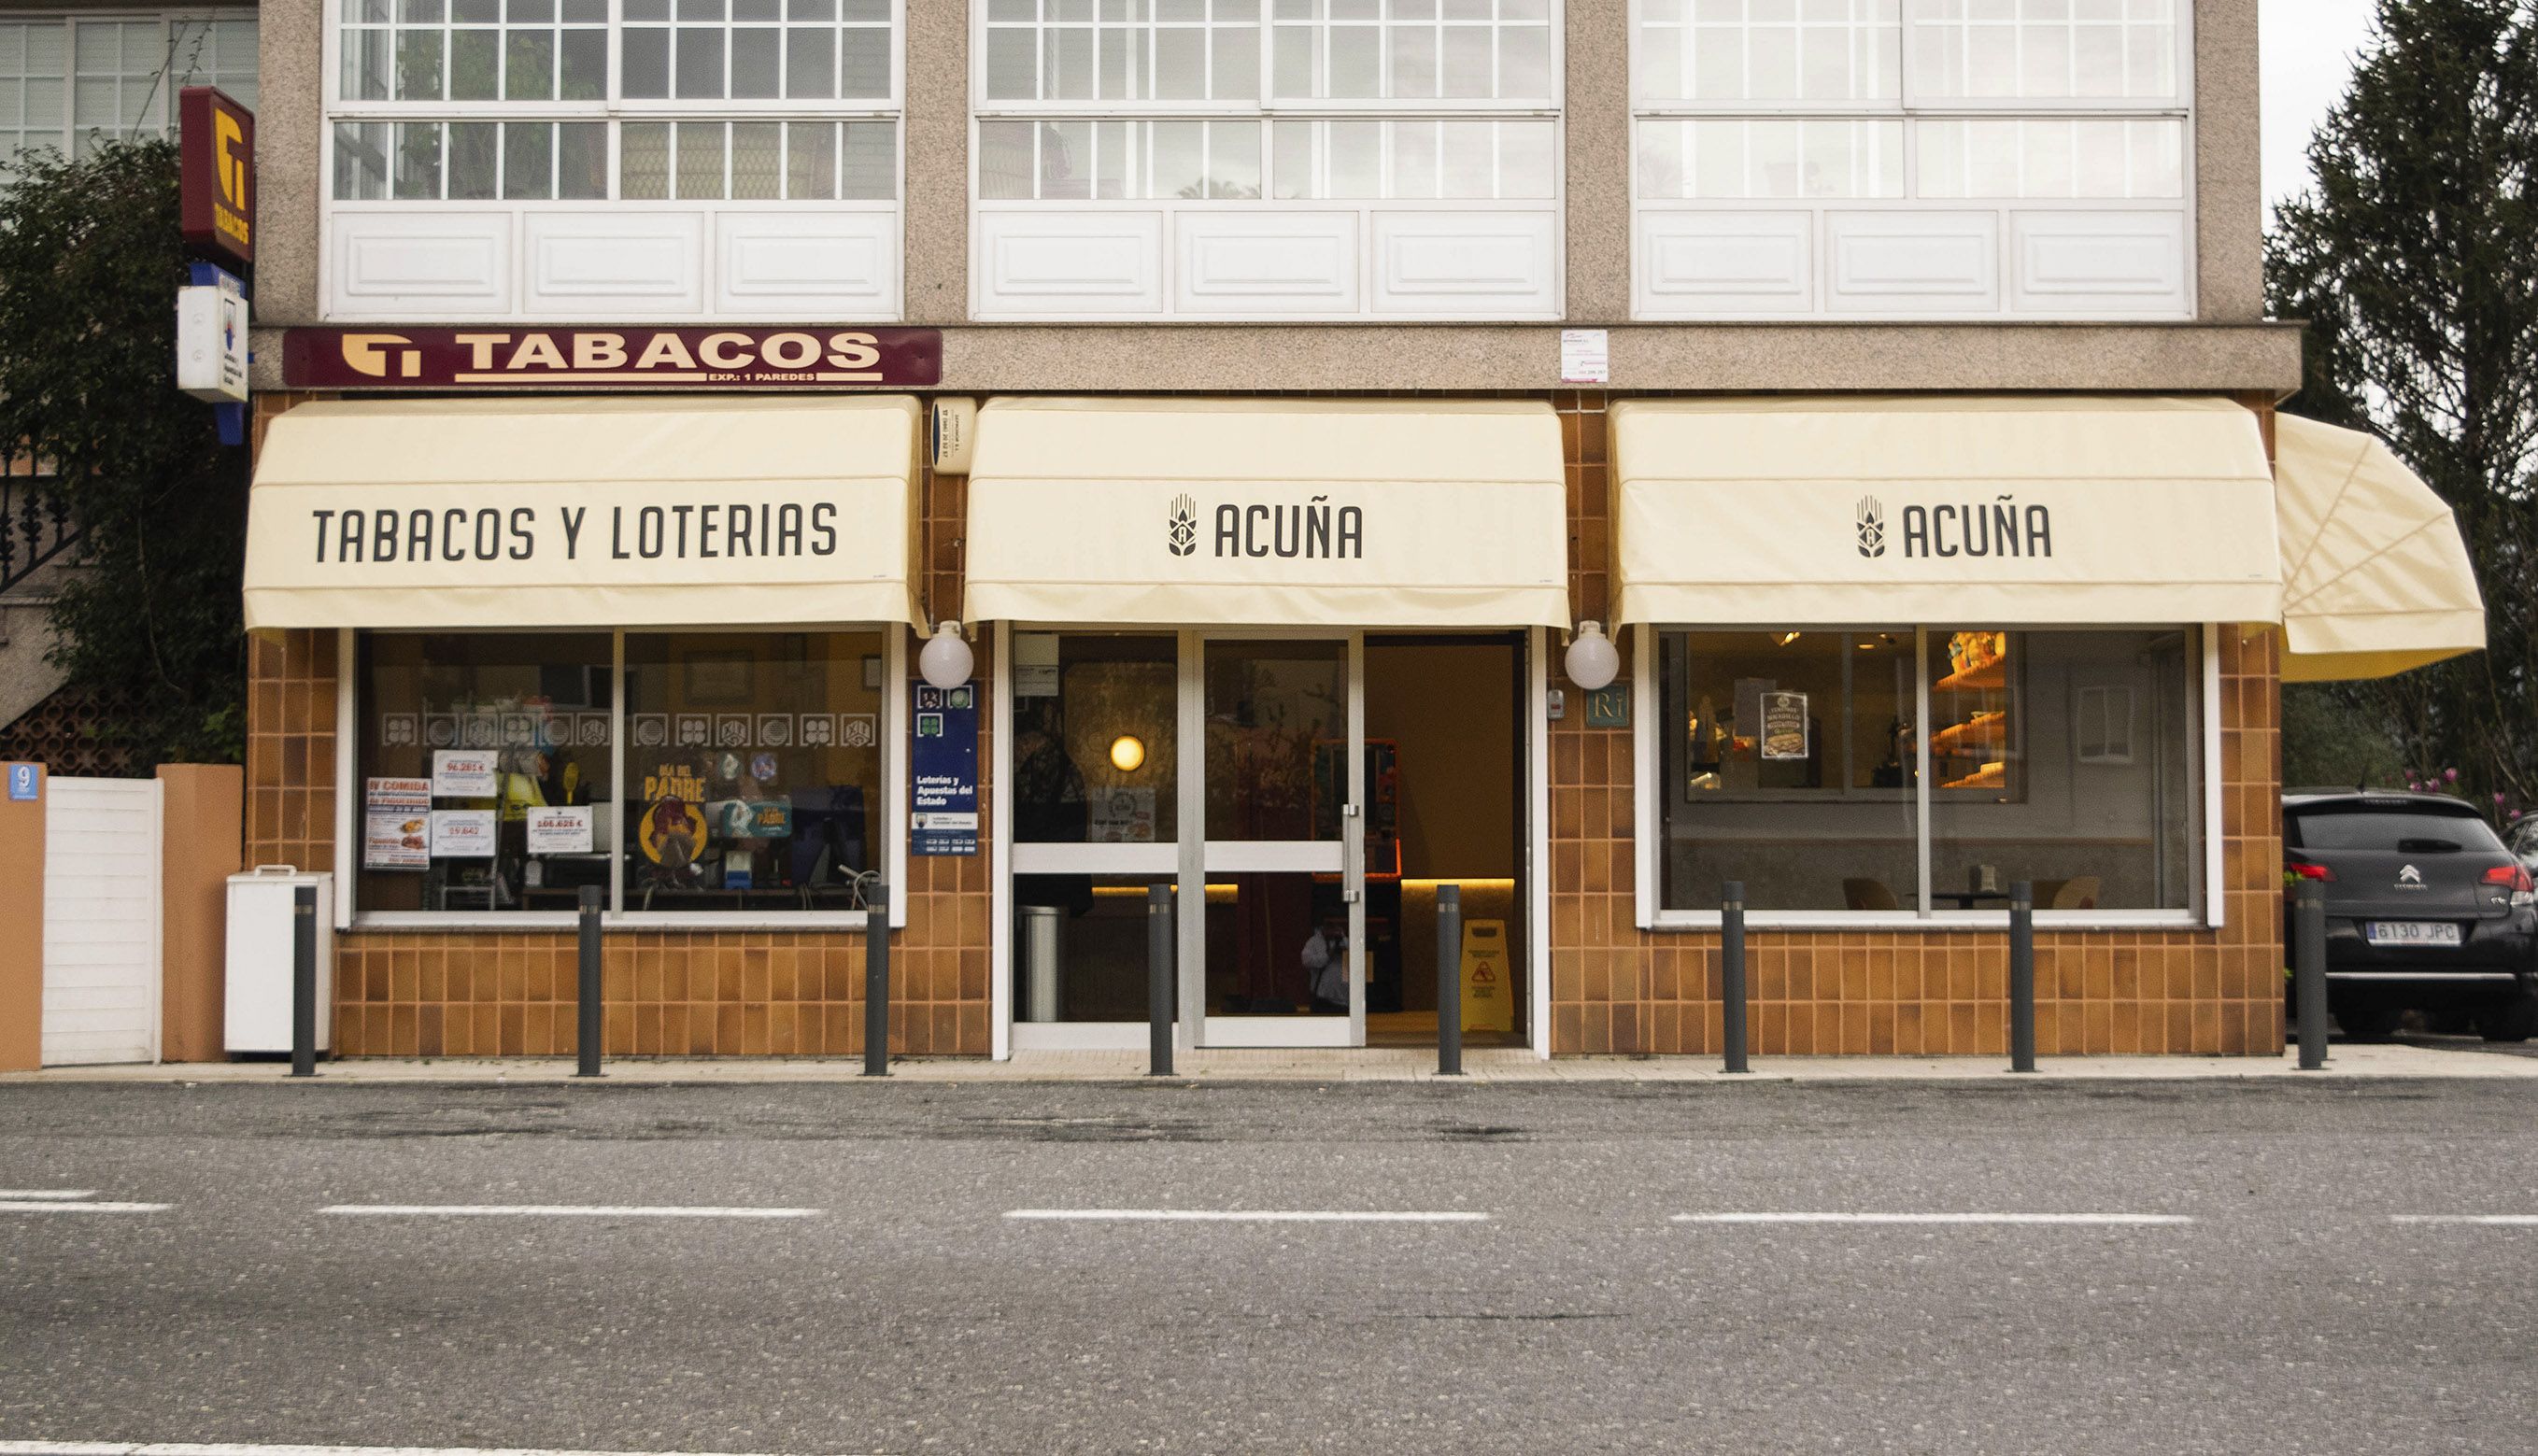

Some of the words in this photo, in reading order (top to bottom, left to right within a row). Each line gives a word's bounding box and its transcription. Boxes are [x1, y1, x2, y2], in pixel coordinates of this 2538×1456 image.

[455, 332, 883, 371] TABACOS
[744, 373, 751, 381] 1
[755, 373, 815, 381] PAREDES
[312, 506, 535, 562] TABACOS
[560, 506, 587, 560] Y
[611, 502, 839, 560] LOTERIAS
[1214, 495, 1363, 558] ACUÑA
[1902, 494, 2052, 558] ACUÑA
[17, 766, 32, 786] 9
[953, 777, 959, 786] y
[645, 775, 706, 802] PADRE
[917, 785, 957, 796] Apuestas
[958, 785, 973, 795] del
[916, 797, 947, 805] Estado
[2378, 924, 2419, 939] 6130
[2426, 925, 2454, 939] JPC
